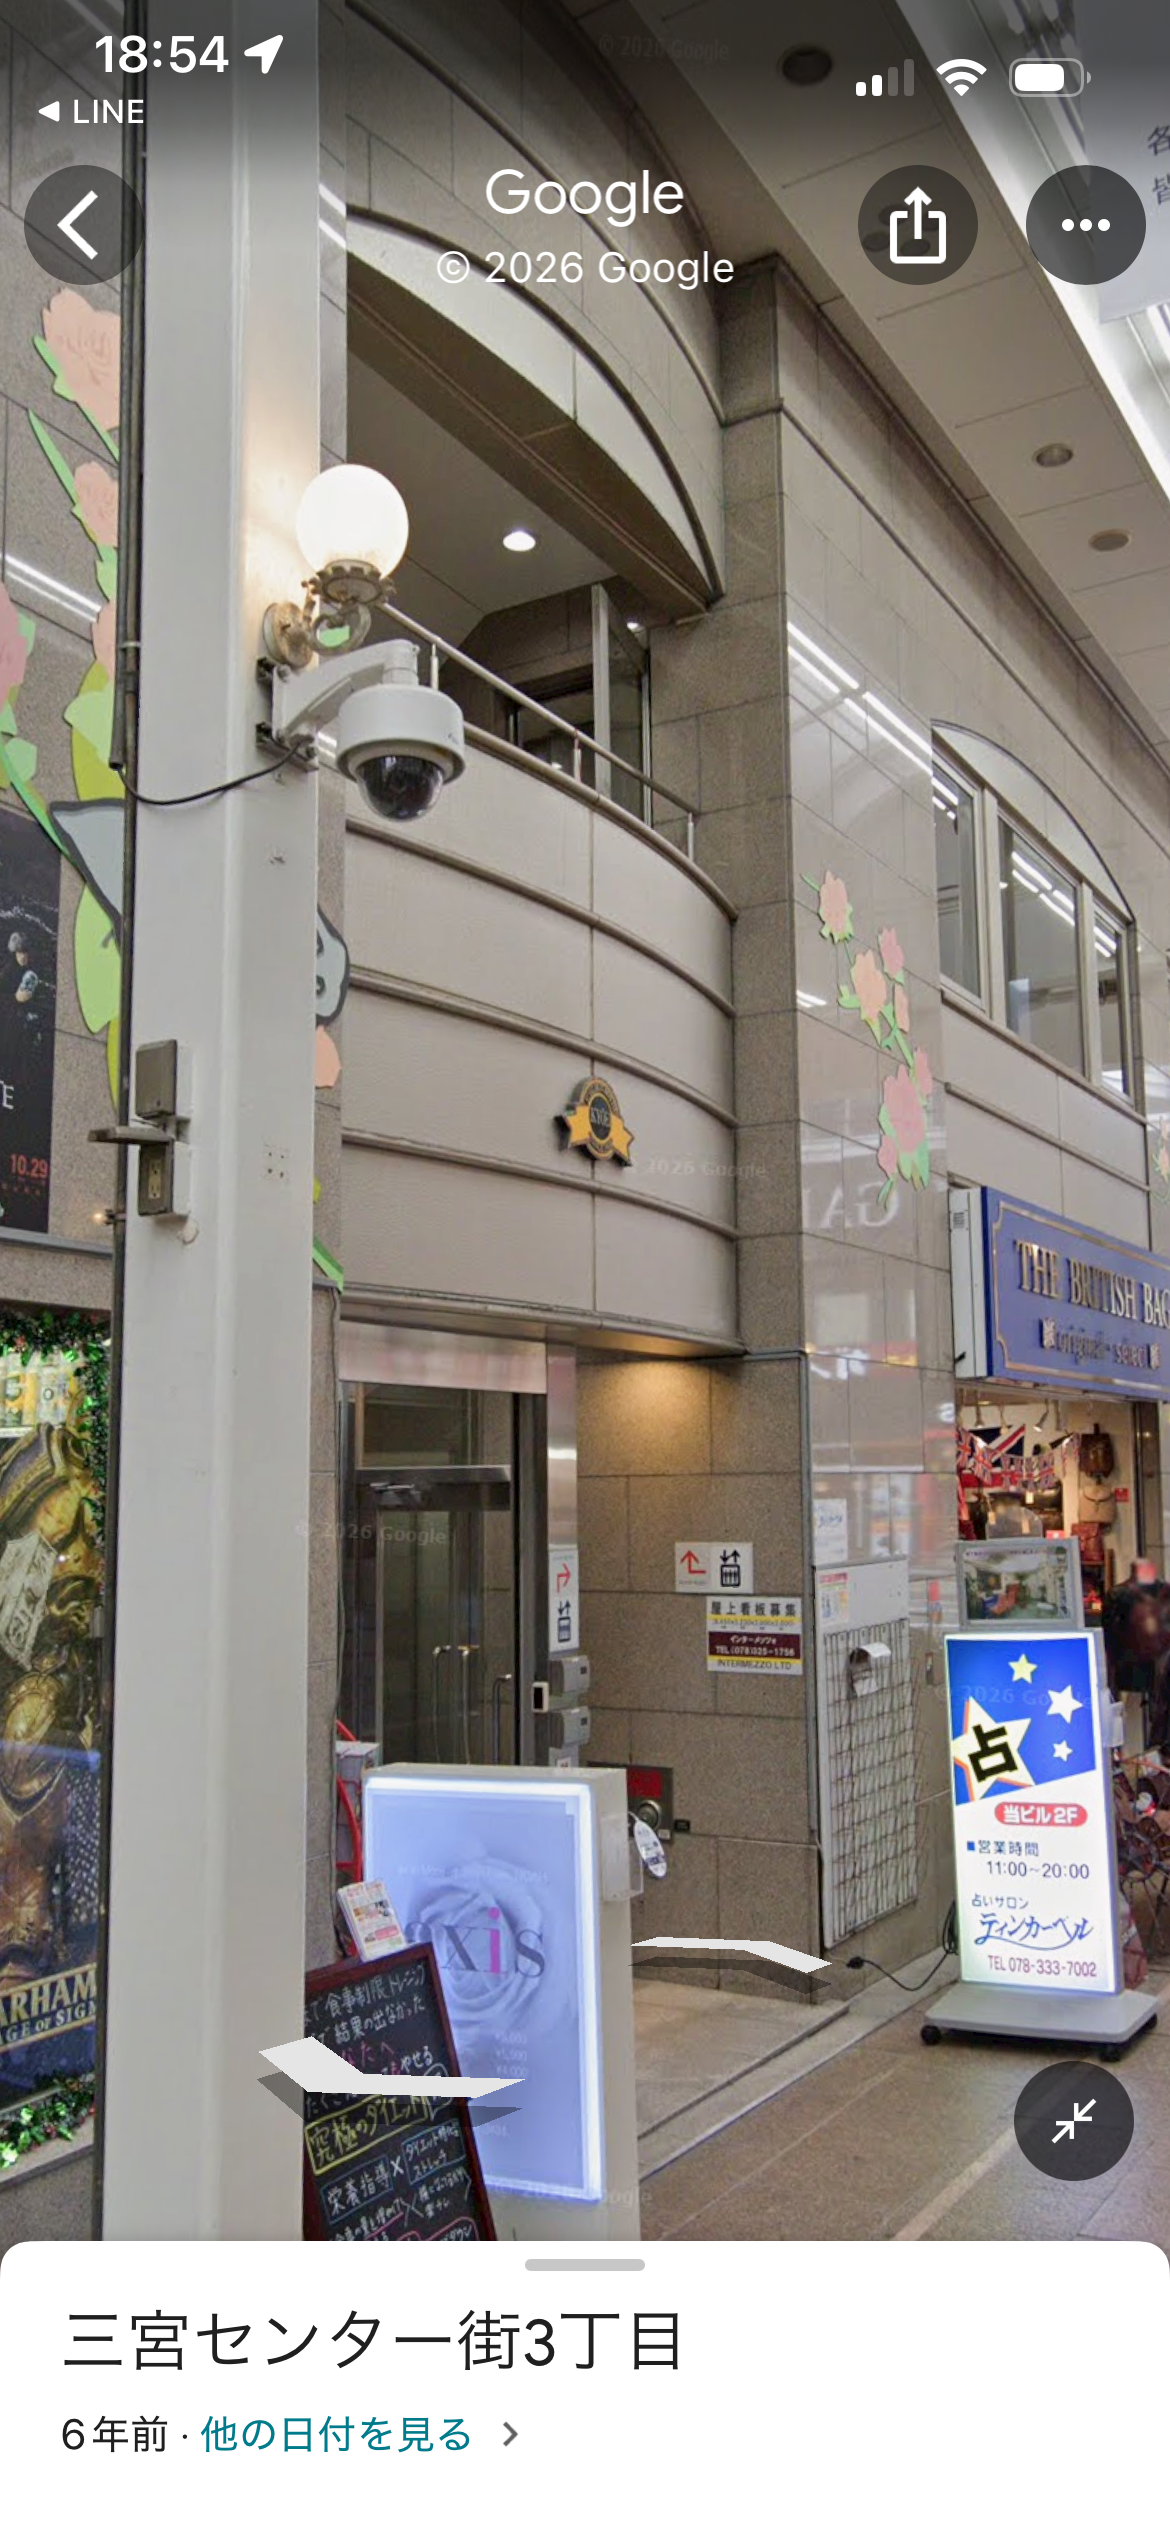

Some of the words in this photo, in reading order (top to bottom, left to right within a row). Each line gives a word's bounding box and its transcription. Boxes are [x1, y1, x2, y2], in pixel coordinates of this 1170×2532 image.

[0, 1081, 14, 1110] E
[11, 1154, 48, 1178] 10.29
[1015, 1239, 1060, 1298] THE
[1067, 1257, 1138, 1321] BRITISH
[968, 1723, 1019, 1783] 占
[1003, 1803, 1078, 1825] 当ビル2F
[978, 1839, 1040, 1857] 営業時間
[971, 1892, 1030, 1911] 占いサロン
[974, 1912, 1094, 1952] ティンカーベル
[988, 1955, 1006, 1971] TEL
[1008, 1956, 1097, 1978] 078-333-7002
